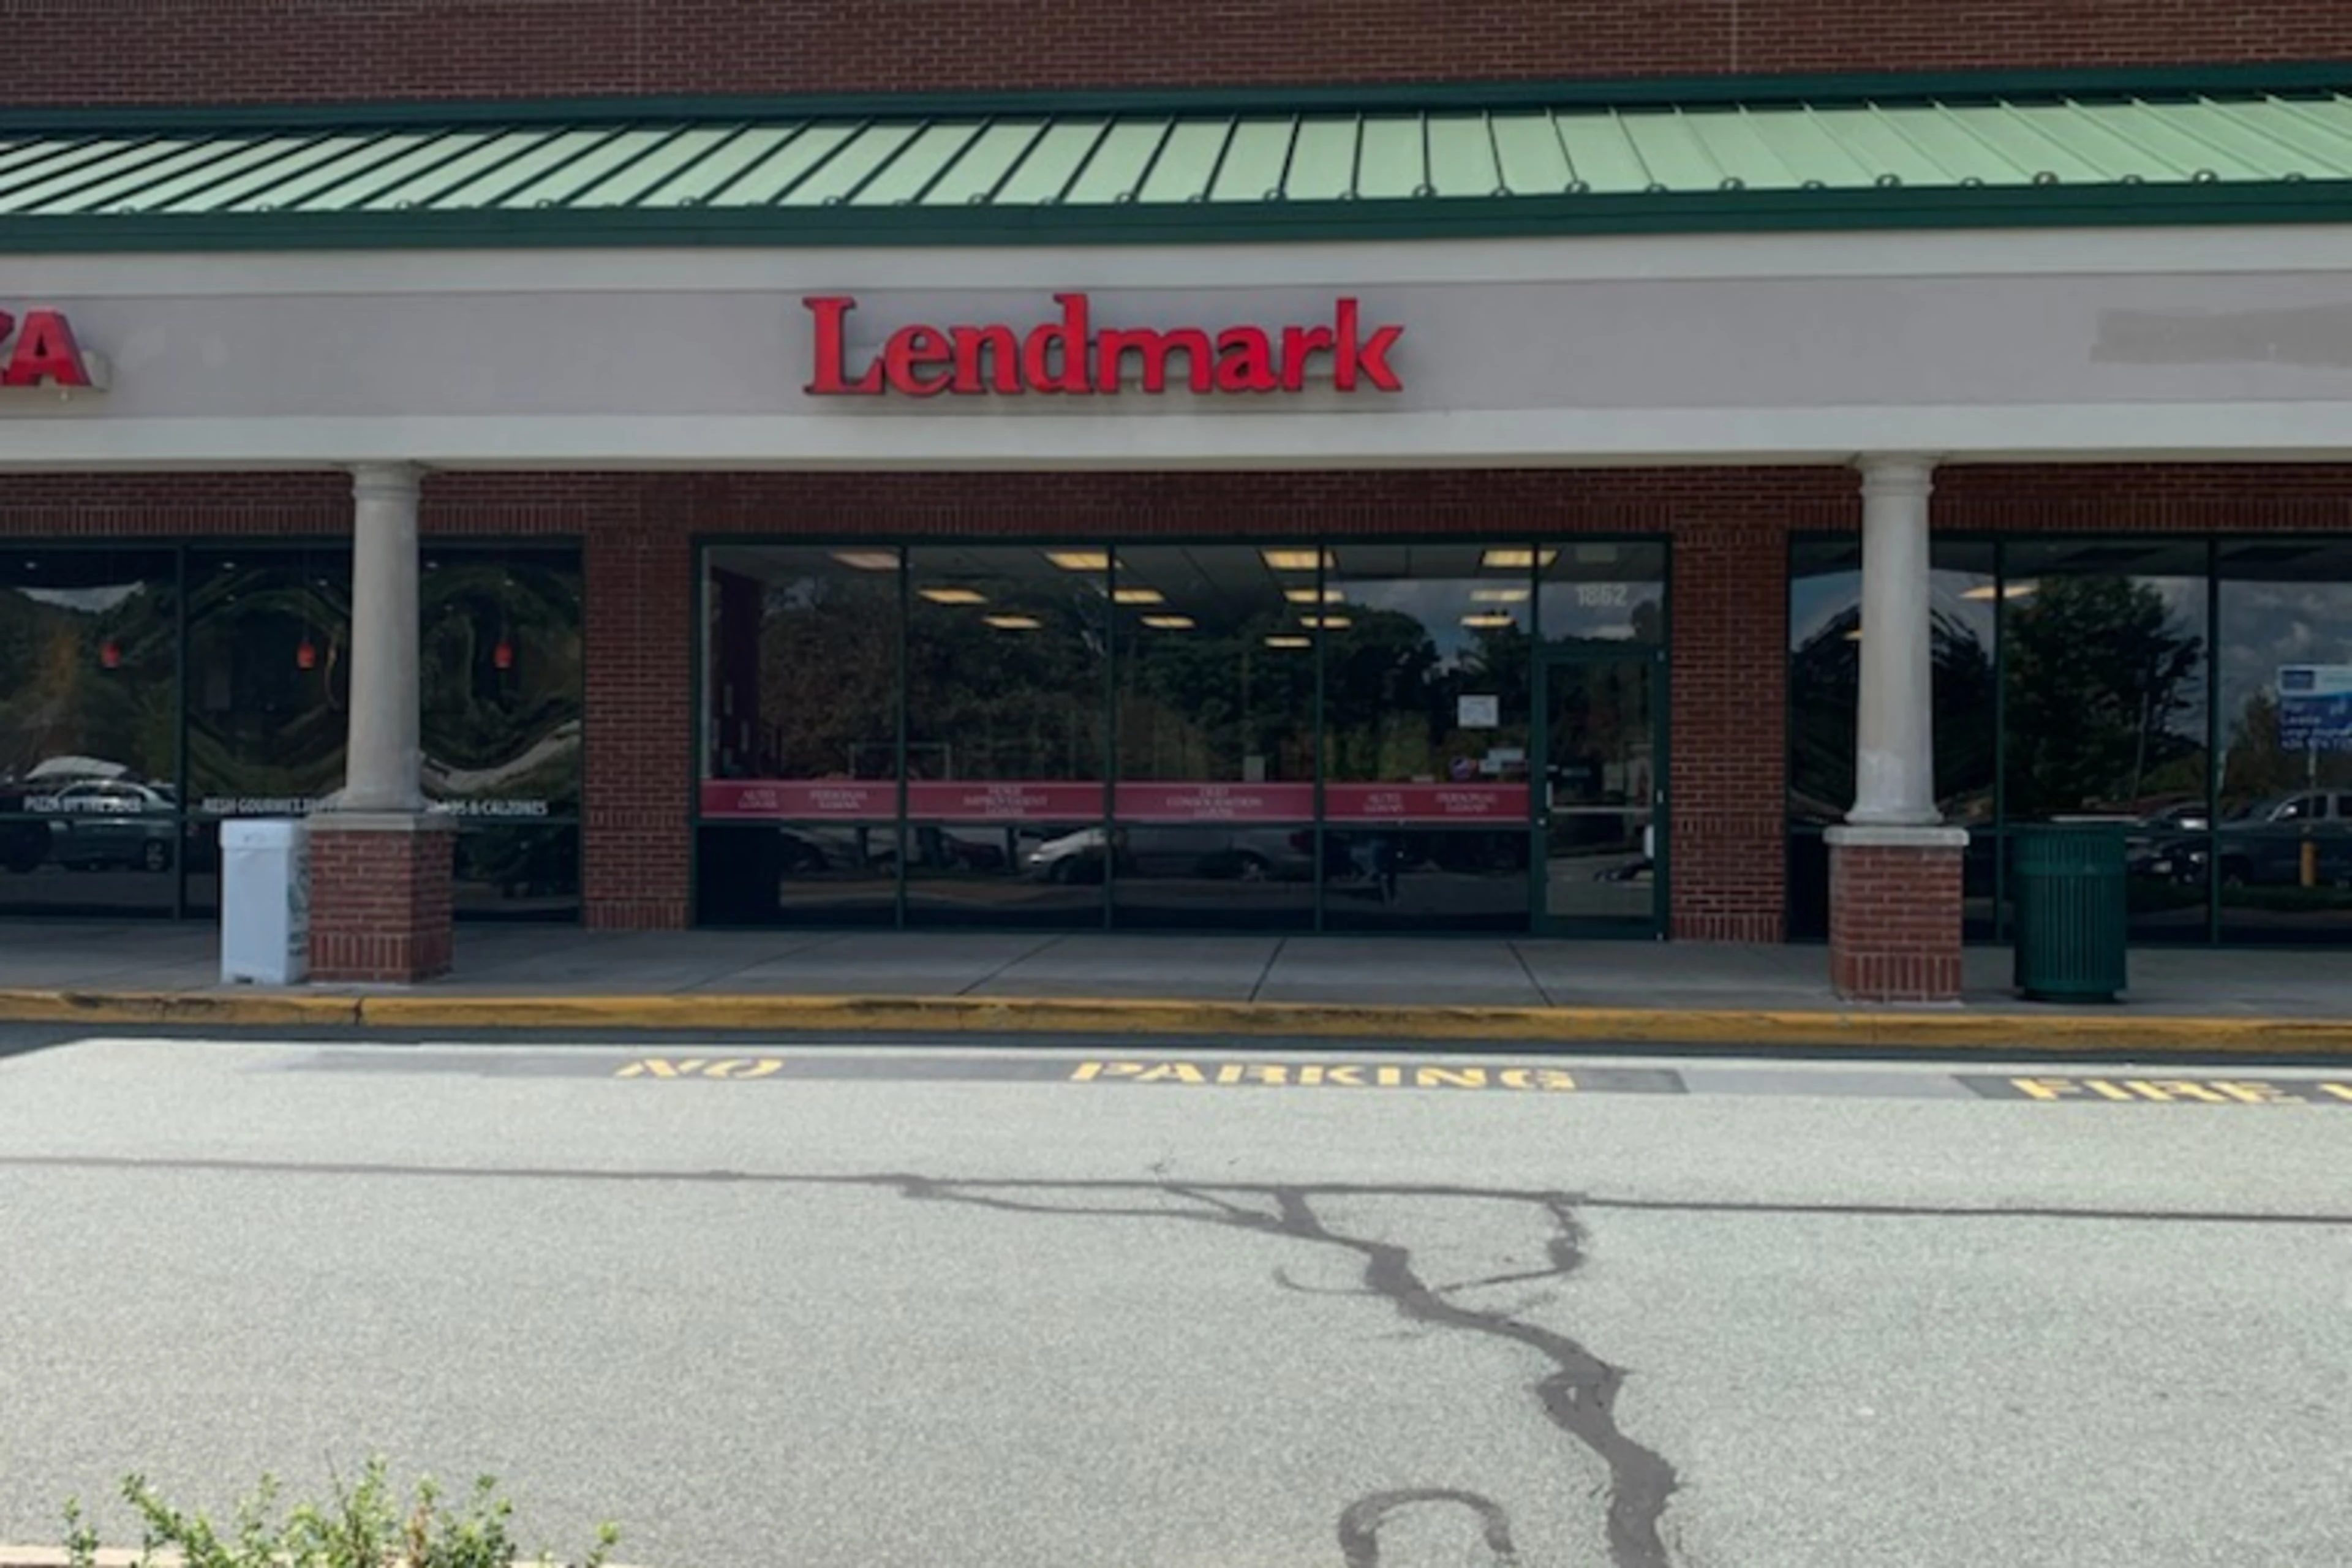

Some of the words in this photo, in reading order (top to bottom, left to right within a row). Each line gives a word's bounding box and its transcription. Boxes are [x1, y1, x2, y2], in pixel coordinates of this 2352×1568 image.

[802, 293, 1404, 397] Lendmark
[614, 1059, 783, 1077] NO
[1070, 1061, 1575, 1089] PARKING
[2009, 1077, 2308, 1103] FIRE
